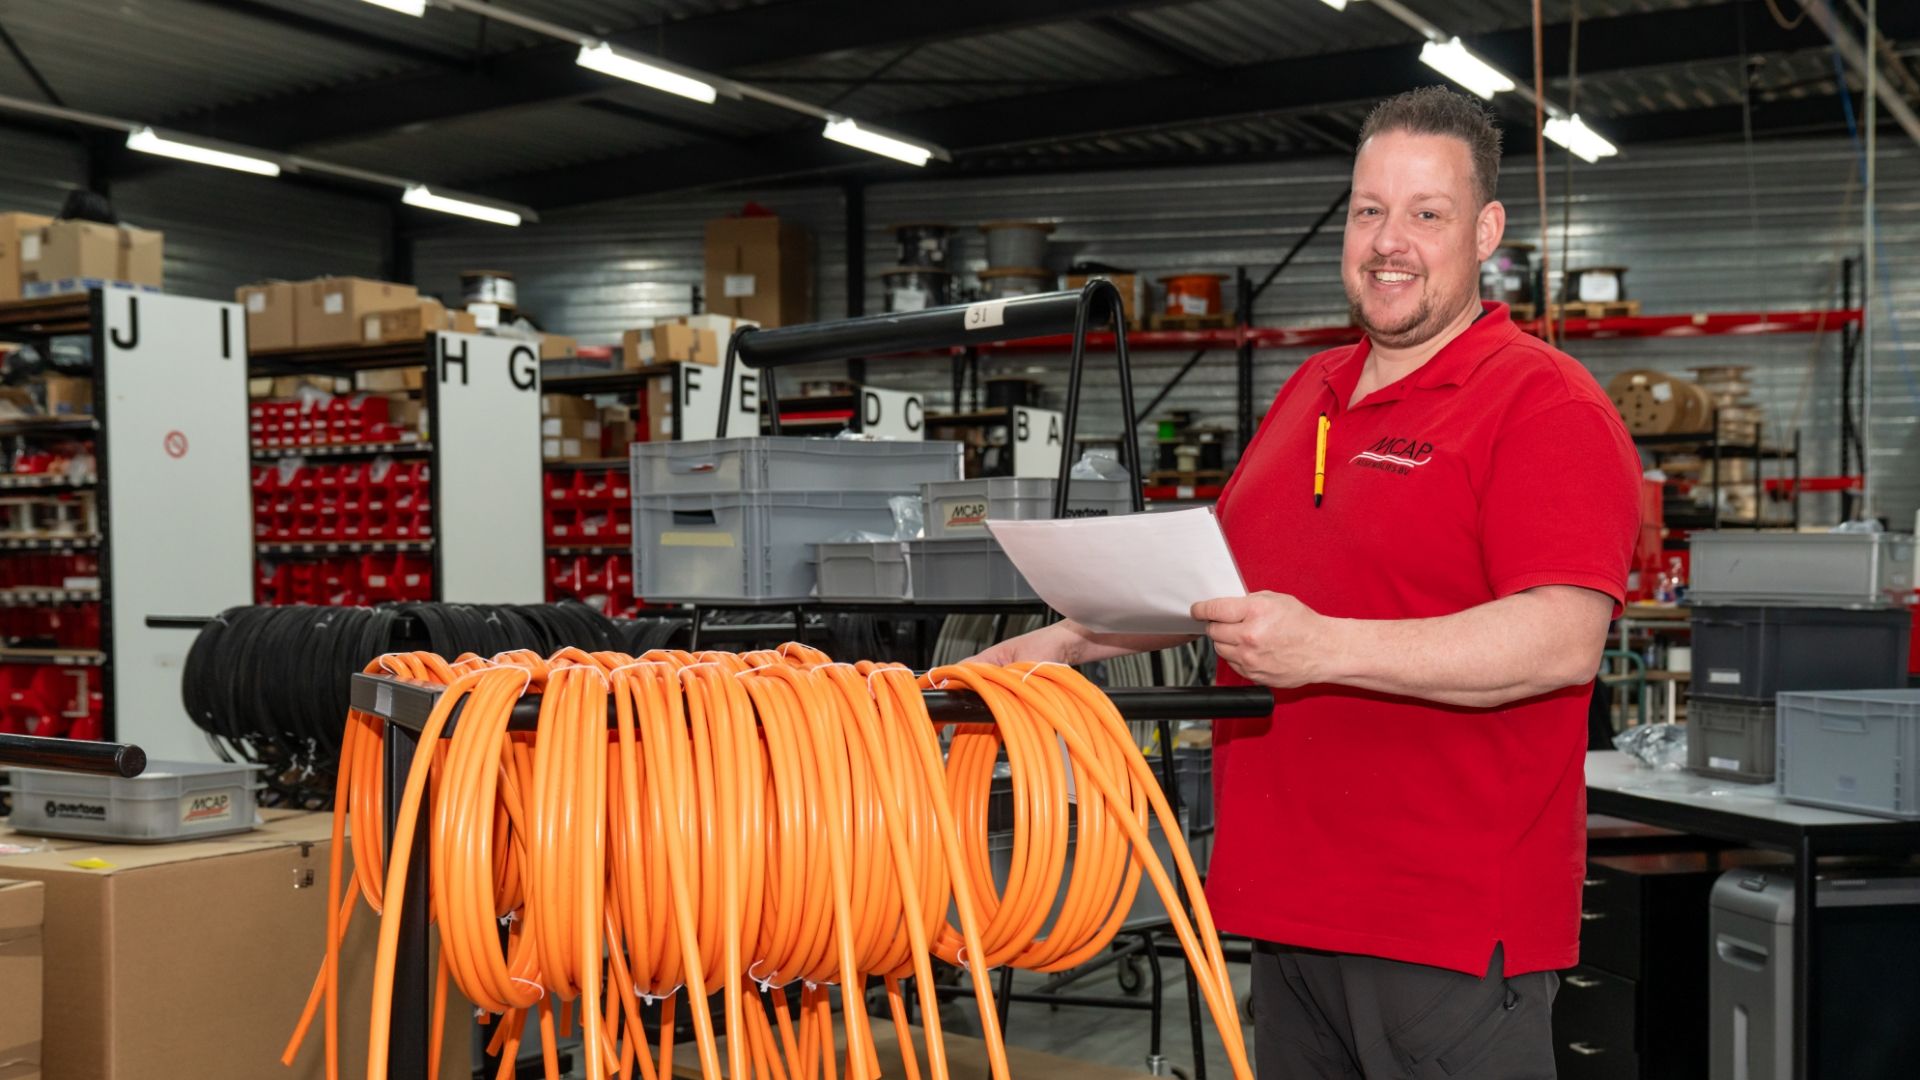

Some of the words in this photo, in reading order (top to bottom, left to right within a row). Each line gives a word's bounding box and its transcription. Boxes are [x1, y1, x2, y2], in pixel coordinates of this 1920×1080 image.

[110, 295, 139, 351] J
[221, 307, 231, 360] I
[441, 336, 468, 386] H
[509, 344, 537, 392] G
[684, 366, 702, 407] F
[740, 374, 757, 413] E
[865, 391, 882, 427] D
[904, 396, 922, 432] C
[1016, 410, 1030, 442] B
[1046, 415, 1062, 447] A
[1367, 436, 1434, 460] MCAP
[951, 504, 985, 518] MCAP
[191, 795, 228, 810] MCAP
